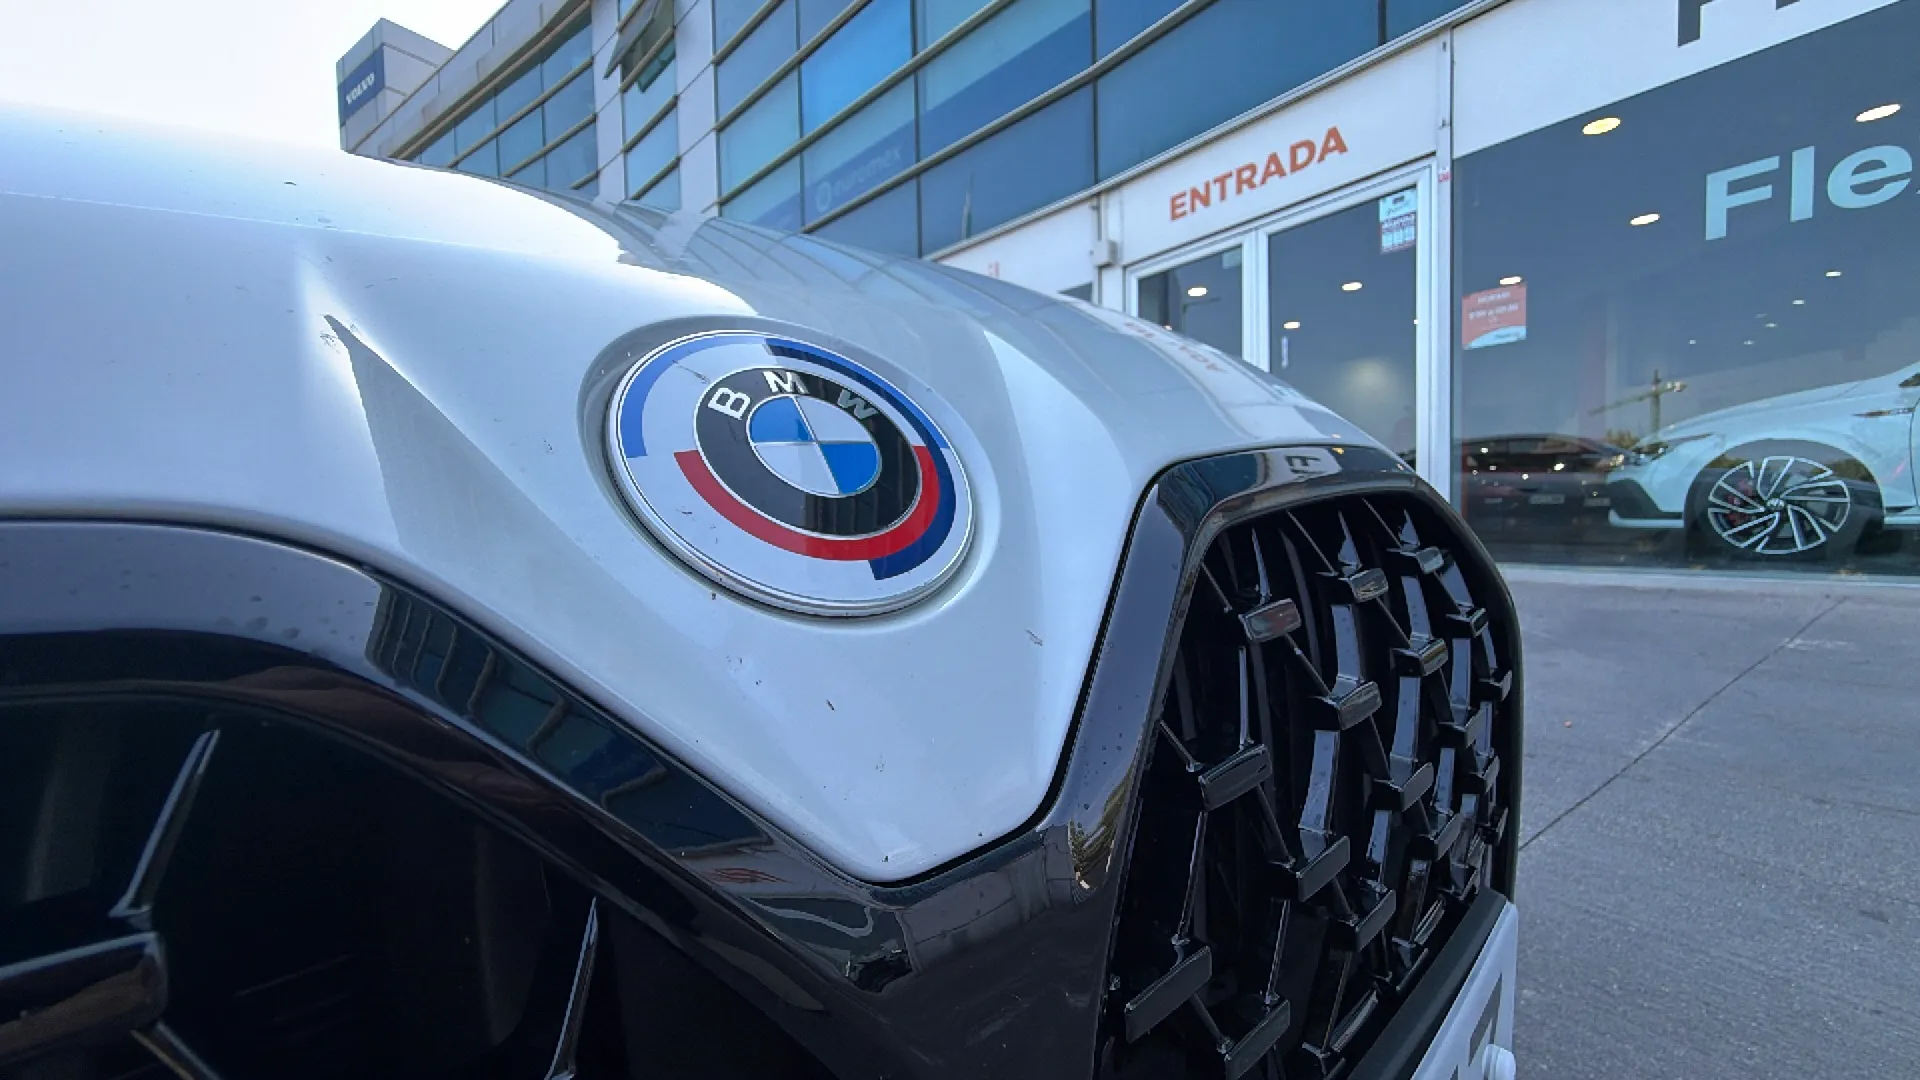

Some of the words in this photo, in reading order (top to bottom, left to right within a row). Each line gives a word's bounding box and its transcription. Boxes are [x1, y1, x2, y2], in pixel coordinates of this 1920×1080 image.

[345, 71, 375, 105] VOLVO
[1170, 126, 1349, 221] ENTRADA
[1705, 145, 1920, 241] Fle
[707, 370, 878, 421] BMW
